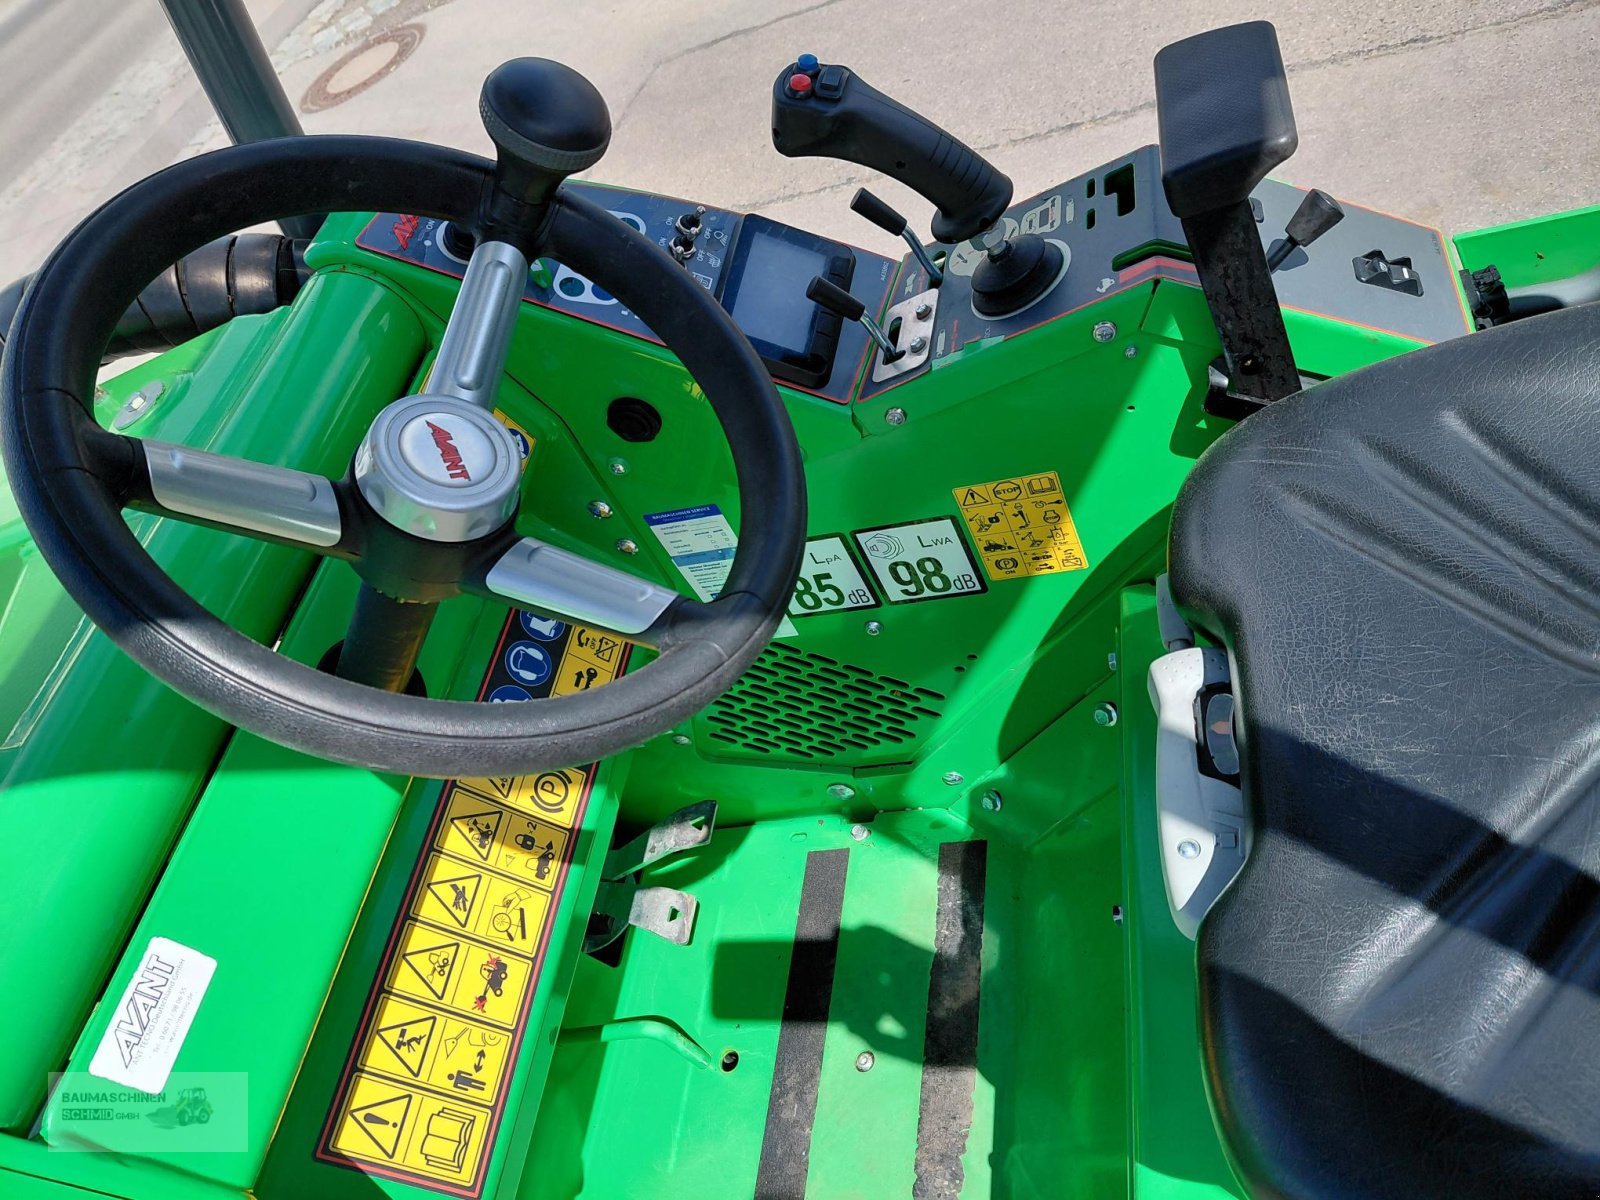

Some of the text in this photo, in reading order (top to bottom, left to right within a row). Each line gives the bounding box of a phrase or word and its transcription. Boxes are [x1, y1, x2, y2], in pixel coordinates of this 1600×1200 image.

[426, 220, 435, 230] ON
[666, 216, 674, 226] ON
[704, 227, 712, 239] OFF
[659, 236, 667, 247] ON
[697, 250, 705, 262] OFF
[425, 420, 471, 481] AVANT
[888, 557, 976, 597] 98 dB
[795, 572, 870, 610] 85 dB
[114, 953, 174, 1069] AVANT
